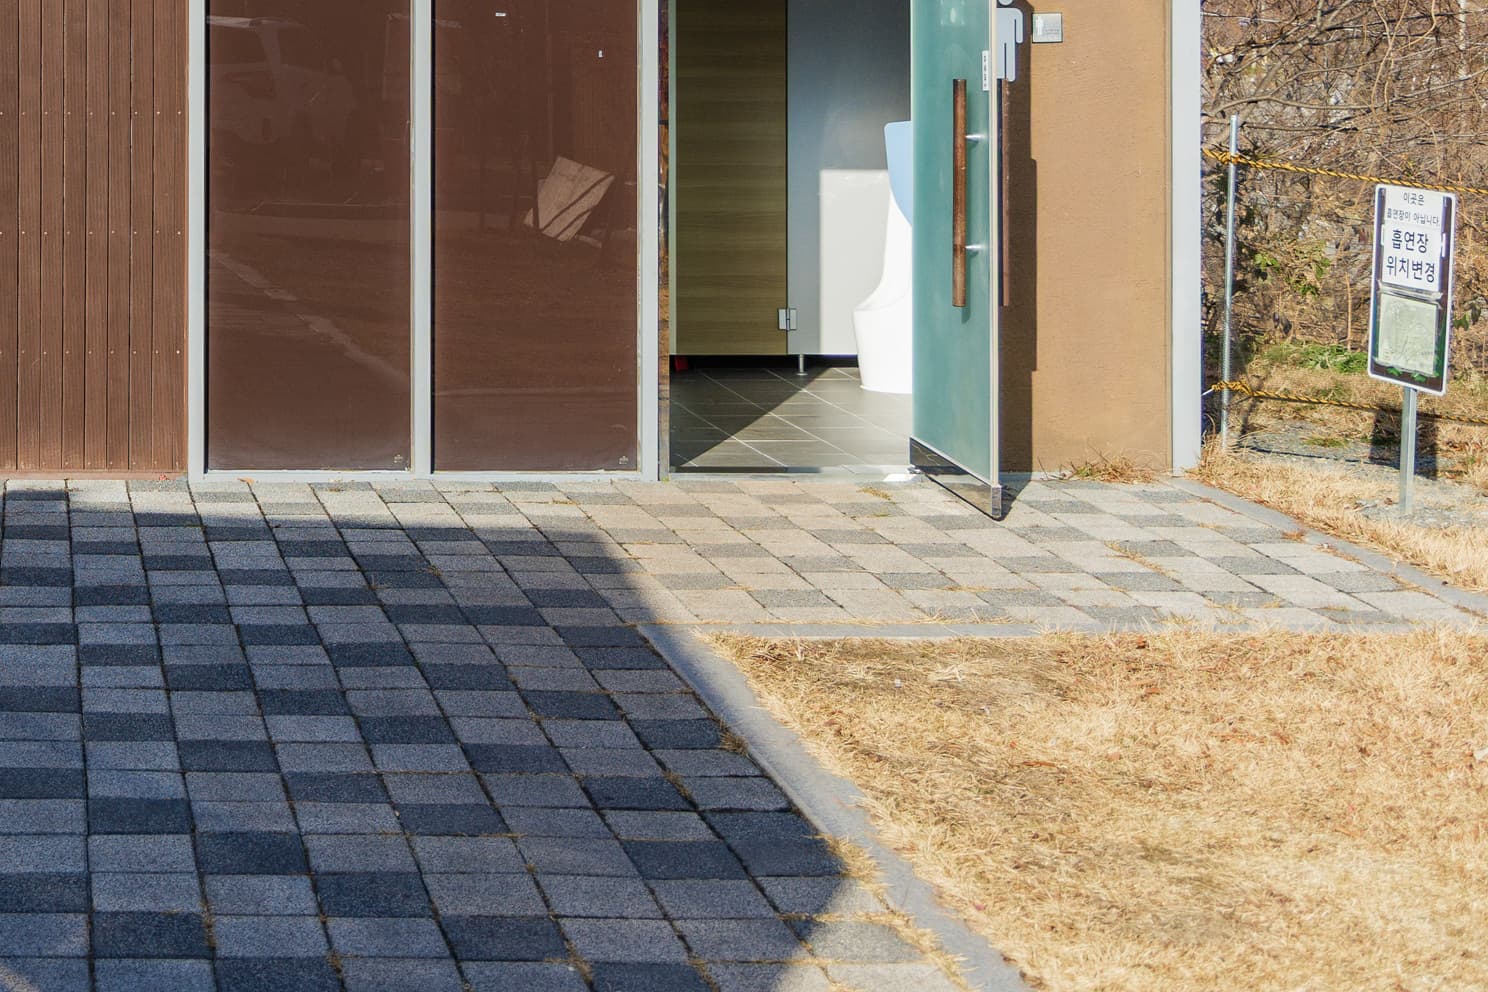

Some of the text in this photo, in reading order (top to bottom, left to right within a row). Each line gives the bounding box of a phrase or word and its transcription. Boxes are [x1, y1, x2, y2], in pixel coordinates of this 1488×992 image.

[1402, 192, 1425, 206] 이곳은
[1392, 229, 1429, 253] 흡연장
[1386, 255, 1435, 283] 위치변경
